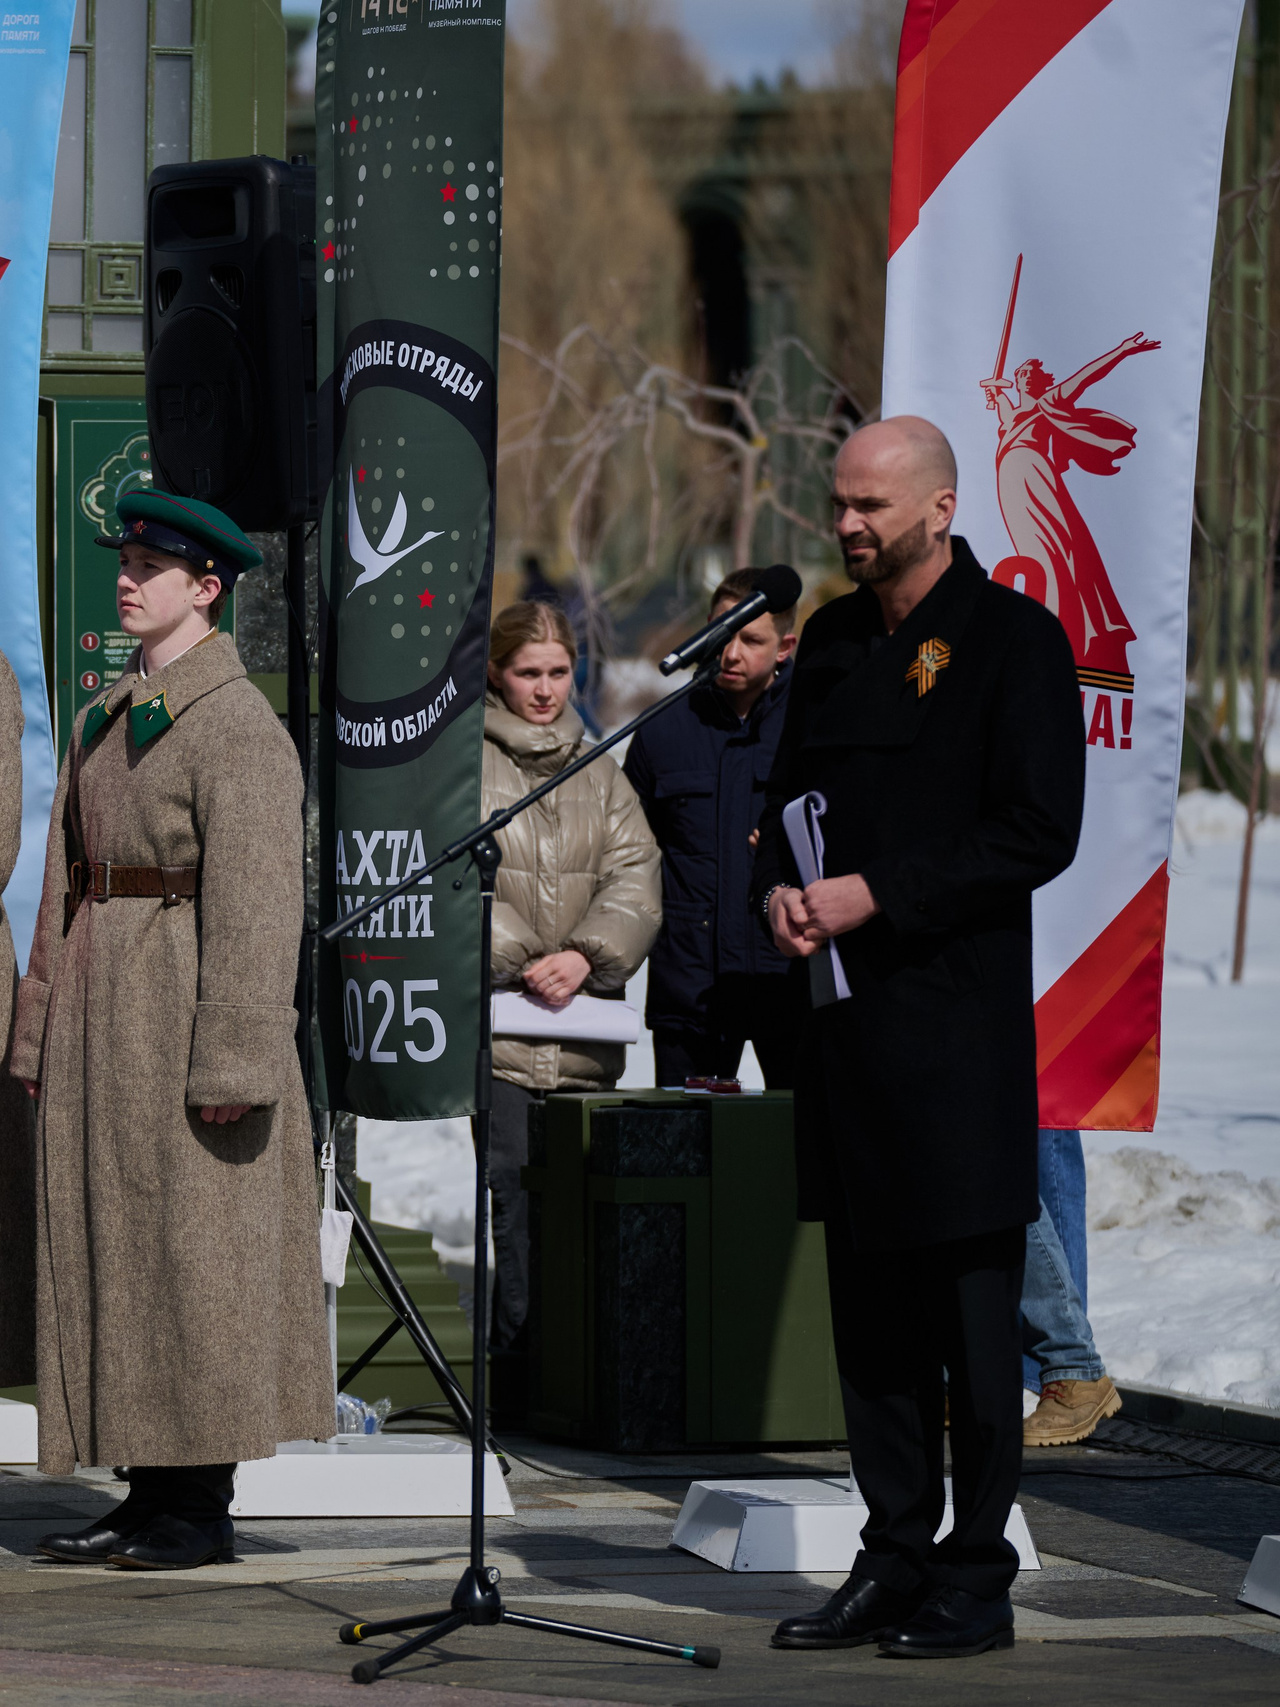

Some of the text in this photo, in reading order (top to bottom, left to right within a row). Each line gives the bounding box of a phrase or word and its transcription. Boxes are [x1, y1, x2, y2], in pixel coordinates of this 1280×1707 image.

[2, 14, 40, 27] ДОРОГА
[428, 18, 502, 28] МУЗЕЙНЫЙ КОМПЛЕКС
[1, 30, 40, 41] ПАМЯТИ
[362, 27, 380, 36] ШАГОВ
[385, 24, 407, 32] ПОБЕДЕ
[397, 342, 484, 402] ОТРЯДЫ
[88, 636, 93, 647] 1
[391, 675, 458, 744] ОБЛАСТИ
[336, 829, 433, 886] АХТА
[344, 978, 447, 1063] 025
